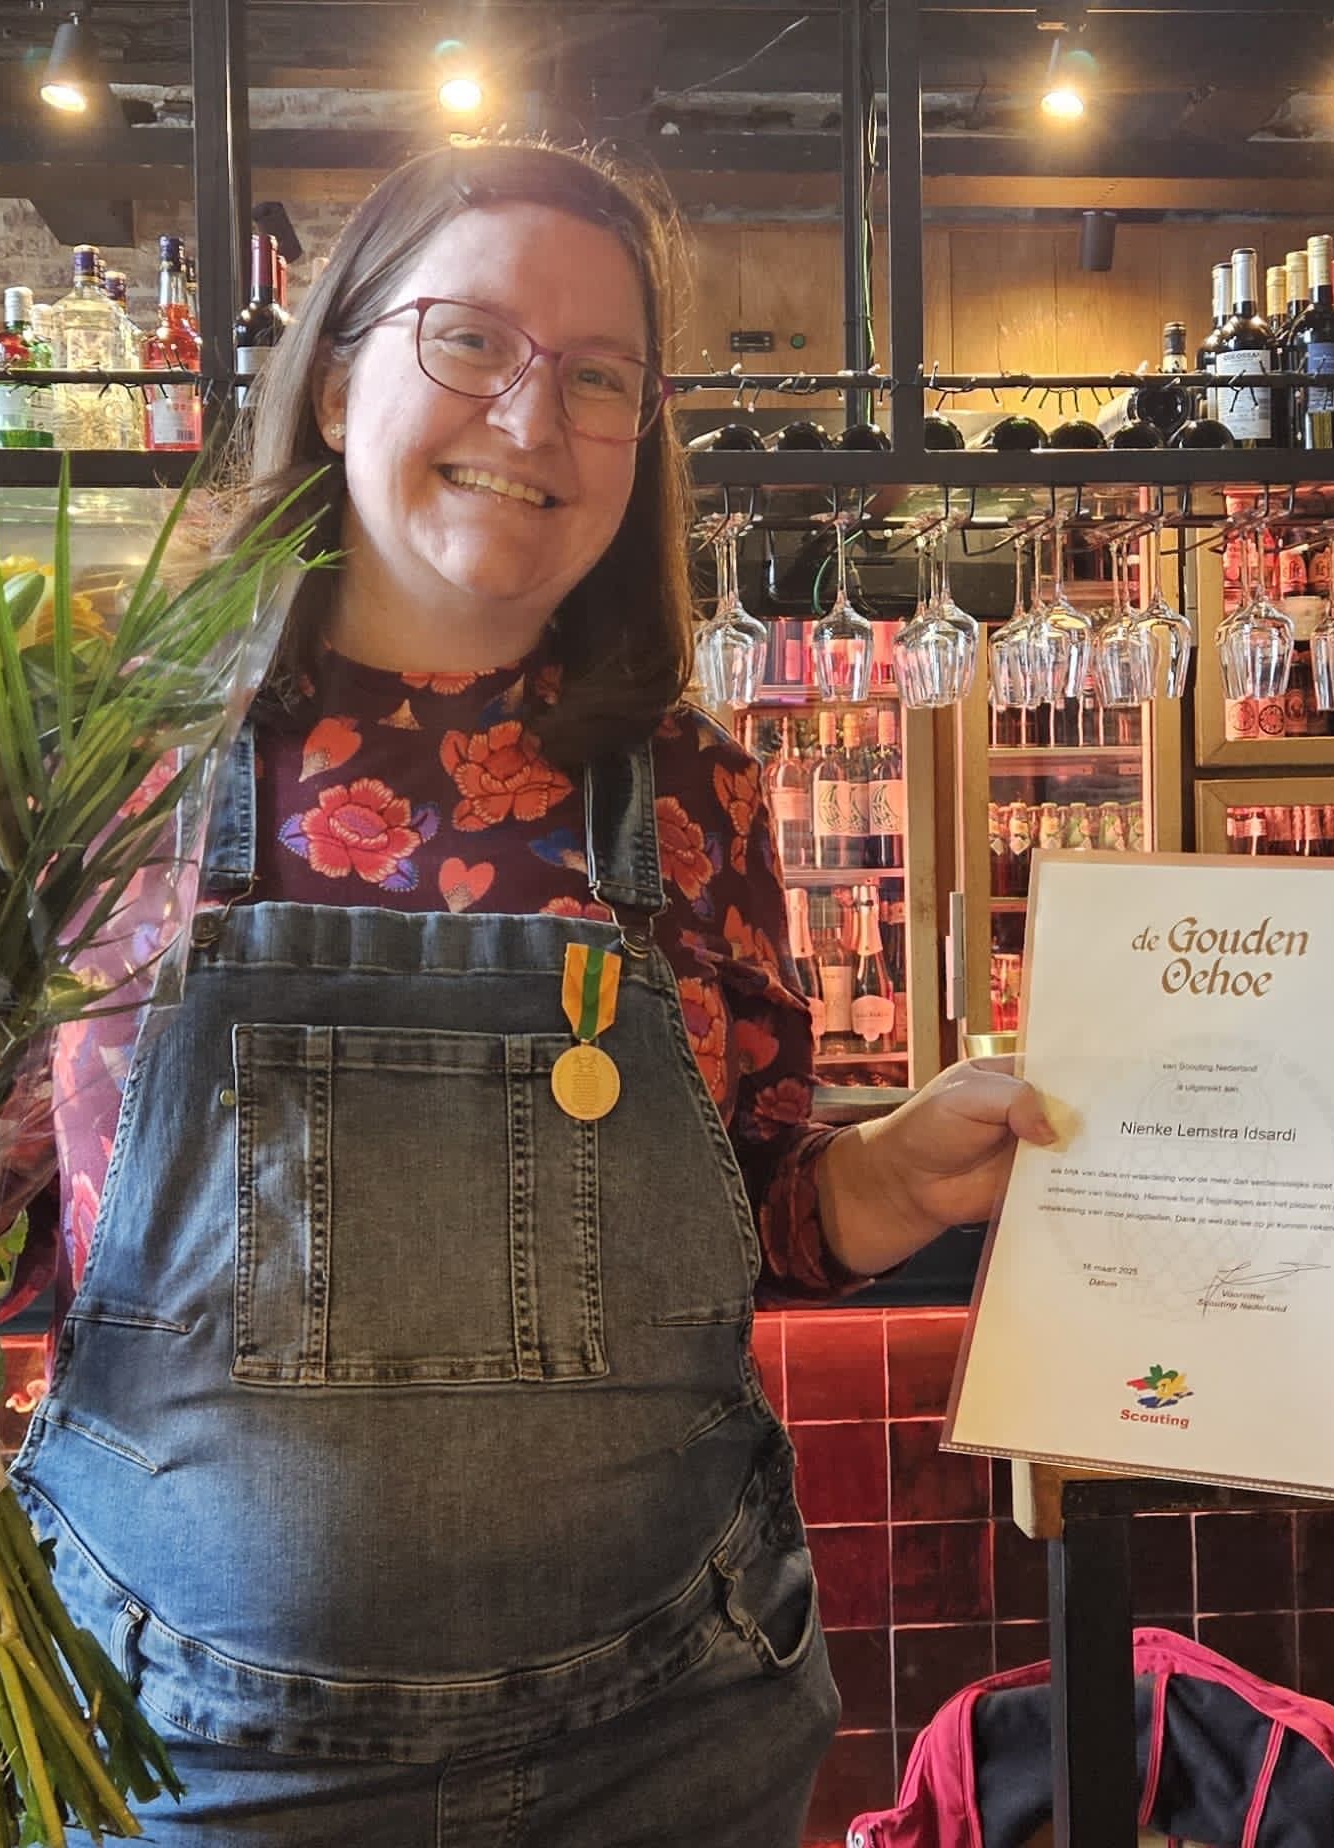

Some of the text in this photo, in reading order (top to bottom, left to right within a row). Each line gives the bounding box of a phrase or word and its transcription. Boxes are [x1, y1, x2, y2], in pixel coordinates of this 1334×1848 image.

[1131, 916, 1309, 956] de Gouden
[1161, 956, 1273, 998] Oehoe
[1179, 1062, 1213, 1073] Scouting
[1216, 1063, 1258, 1073] Nederland
[1120, 1121, 1297, 1142] Nienke Lemstra Idsardi
[1089, 1278, 1118, 1288] Datum
[1240, 1302, 1288, 1314] Nederland
[1120, 1409, 1190, 1430] Scouting
